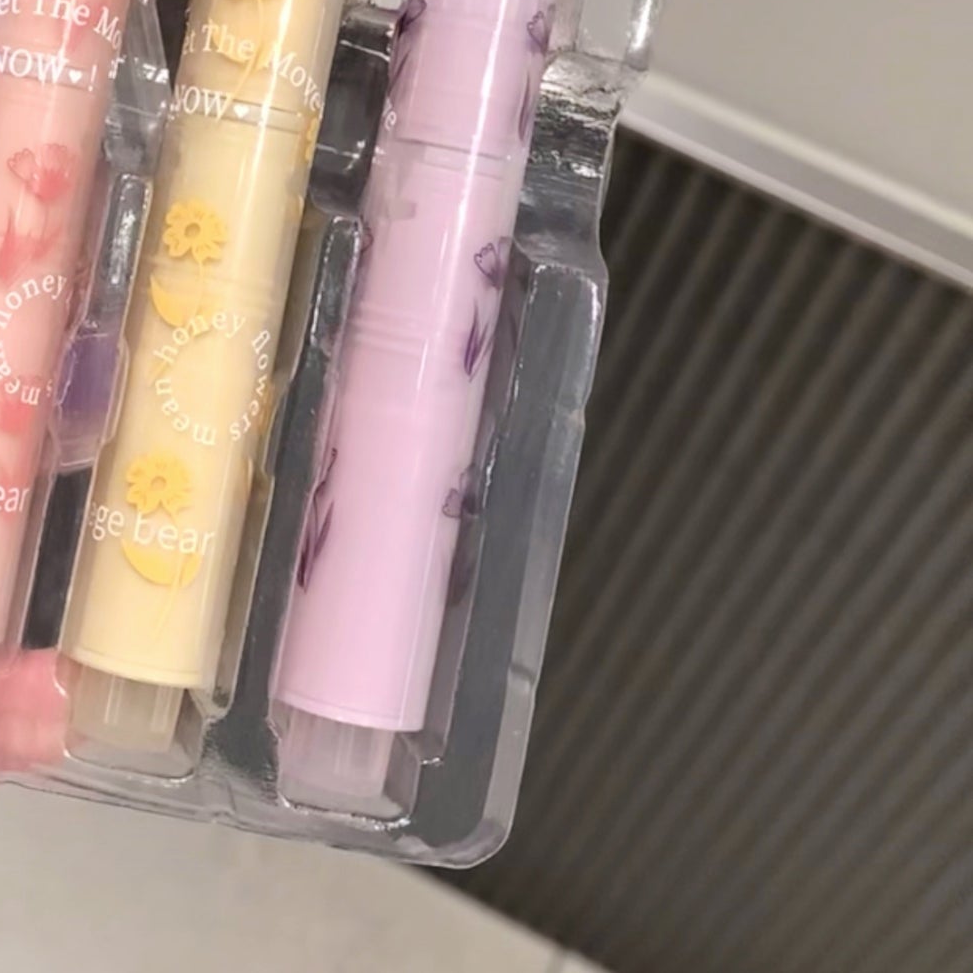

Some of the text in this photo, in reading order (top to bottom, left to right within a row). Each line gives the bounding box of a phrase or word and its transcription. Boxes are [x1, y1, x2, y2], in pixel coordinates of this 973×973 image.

[201, 19, 256, 59] The
[154, 311, 271, 446] flowers mean honey
[133, 512, 215, 557] bear
